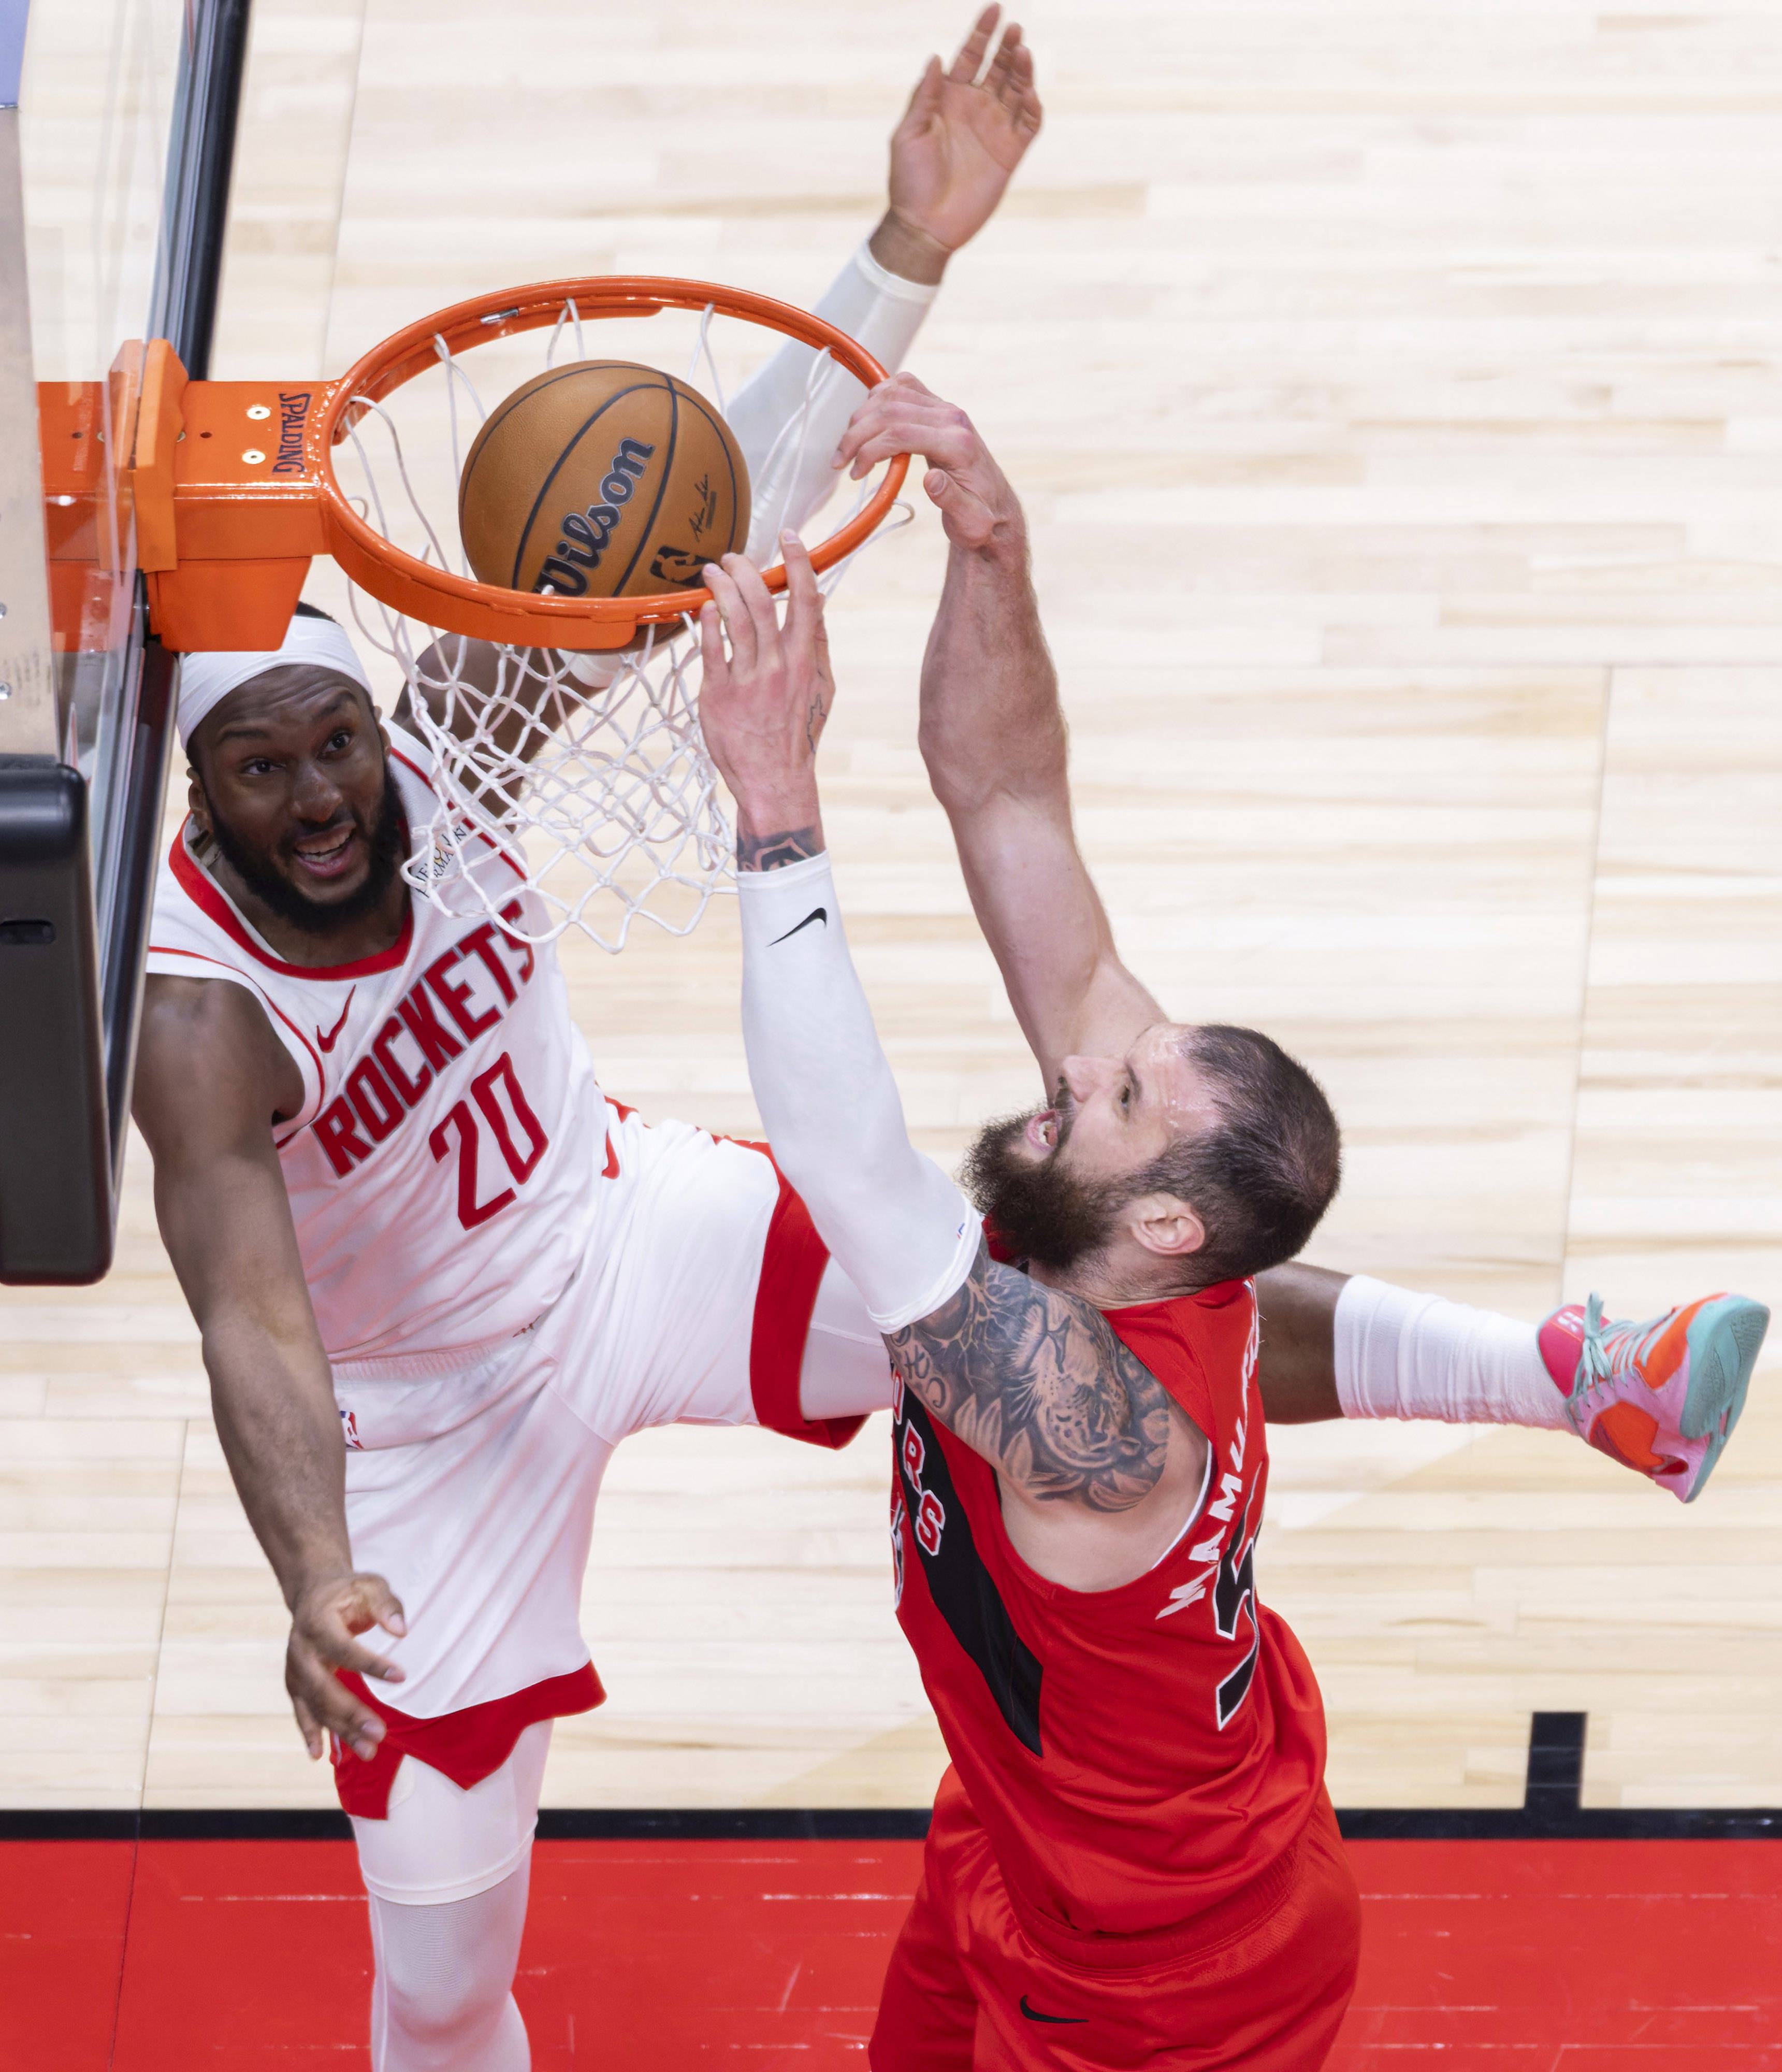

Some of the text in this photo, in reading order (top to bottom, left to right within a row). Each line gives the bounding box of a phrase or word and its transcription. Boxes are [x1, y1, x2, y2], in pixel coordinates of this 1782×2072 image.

[272, 392, 311, 473] SPALDING
[311, 899, 534, 1179] ROCKETS
[429, 1052, 548, 1231] 20
